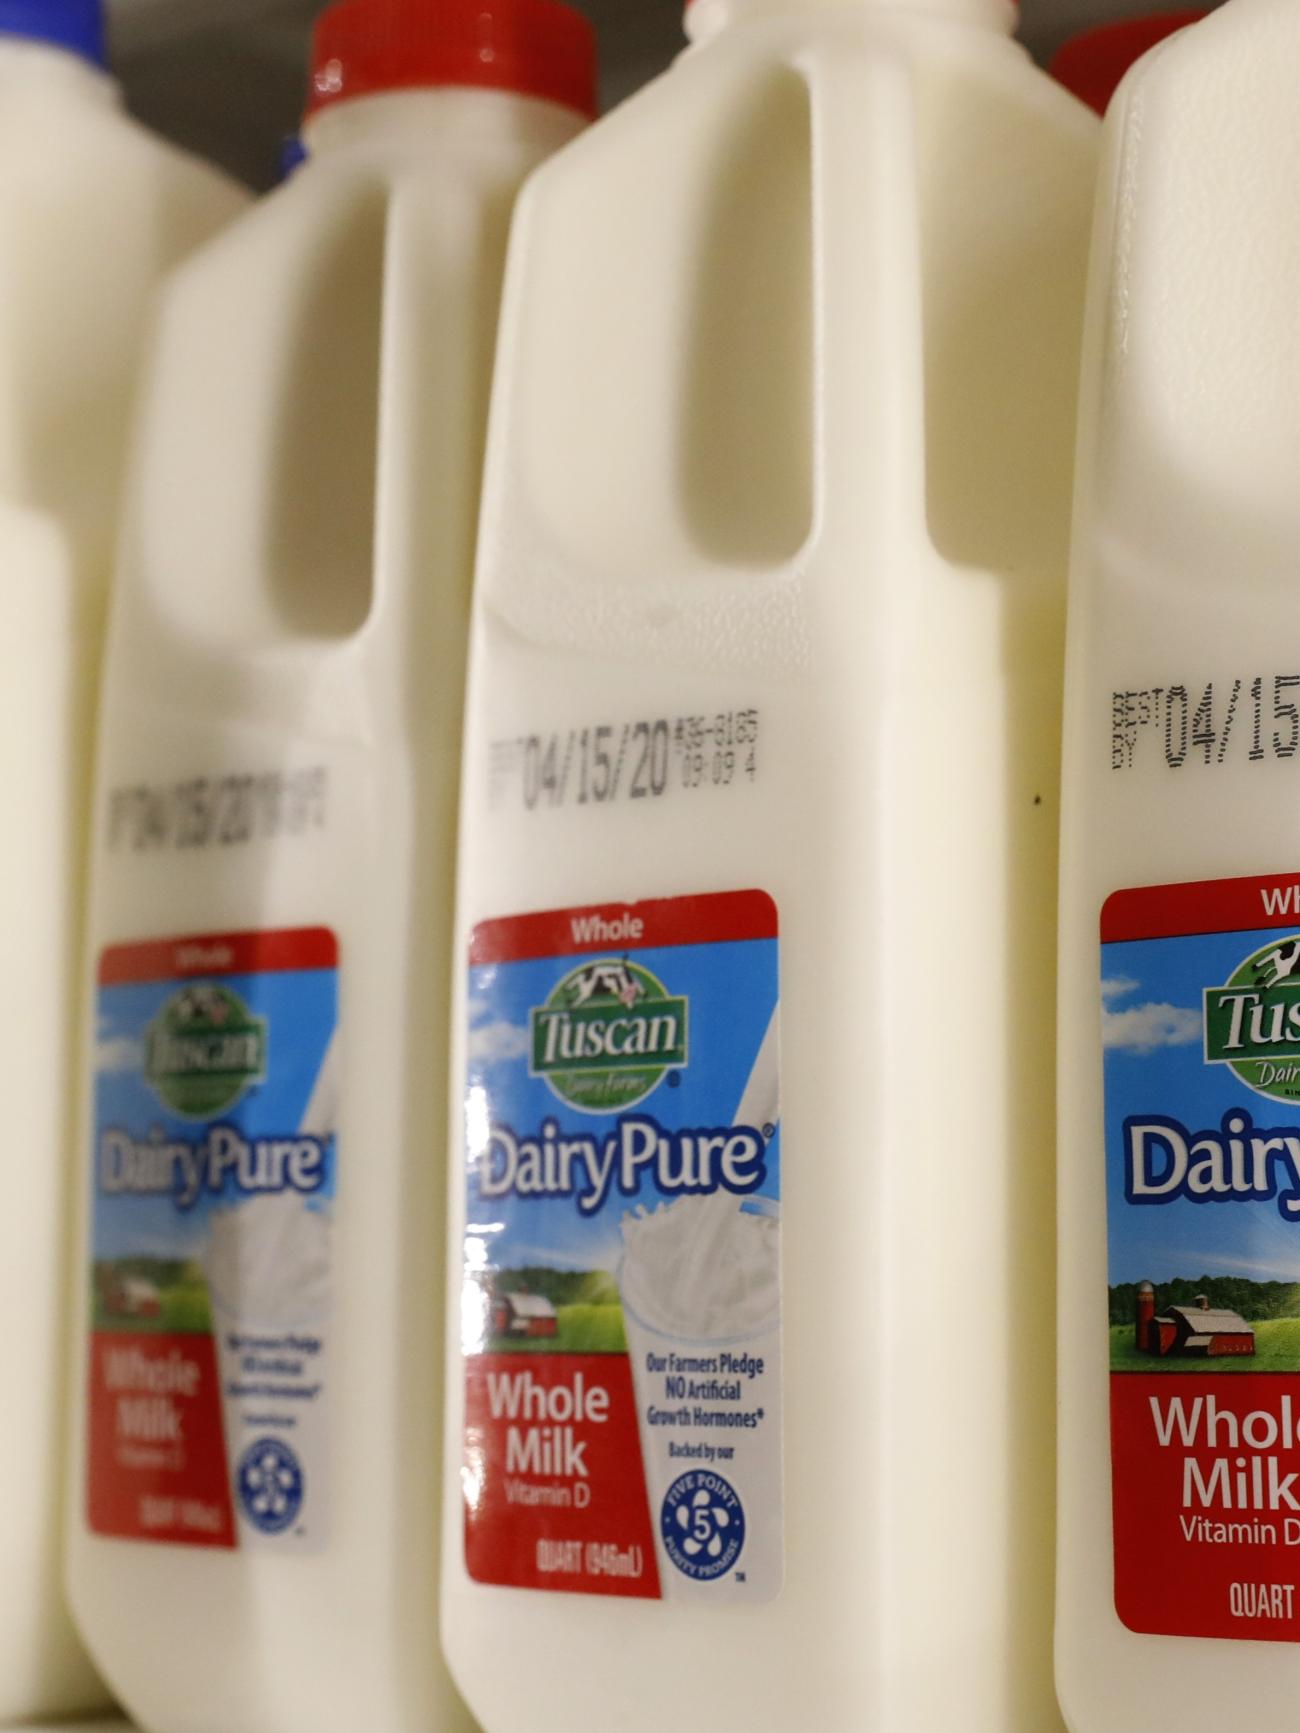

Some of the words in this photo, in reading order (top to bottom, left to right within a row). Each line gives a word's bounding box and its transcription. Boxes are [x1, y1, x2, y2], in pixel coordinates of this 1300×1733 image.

[1111, 687, 1164, 728] BEST
[1111, 730, 1138, 770] BY
[570, 912, 645, 945] Whole
[538, 1011, 678, 1064] Tuscan
[645, 1351, 667, 1373] Our
[668, 1351, 718, 1373] Farmers
[719, 1351, 765, 1380] Pledge
[486, 1370, 610, 1422] Whole
[665, 1375, 686, 1400] NO
[688, 1379, 741, 1400] Artificial
[646, 1405, 691, 1426] Growth
[505, 1425, 589, 1477] Milk
[503, 1478, 573, 1507] Vitamin
[574, 1481, 591, 1509] D
[693, 1508, 711, 1541] 5
[1179, 1514, 1277, 1545] Vitamin
[1229, 1582, 1295, 1620] QUART
